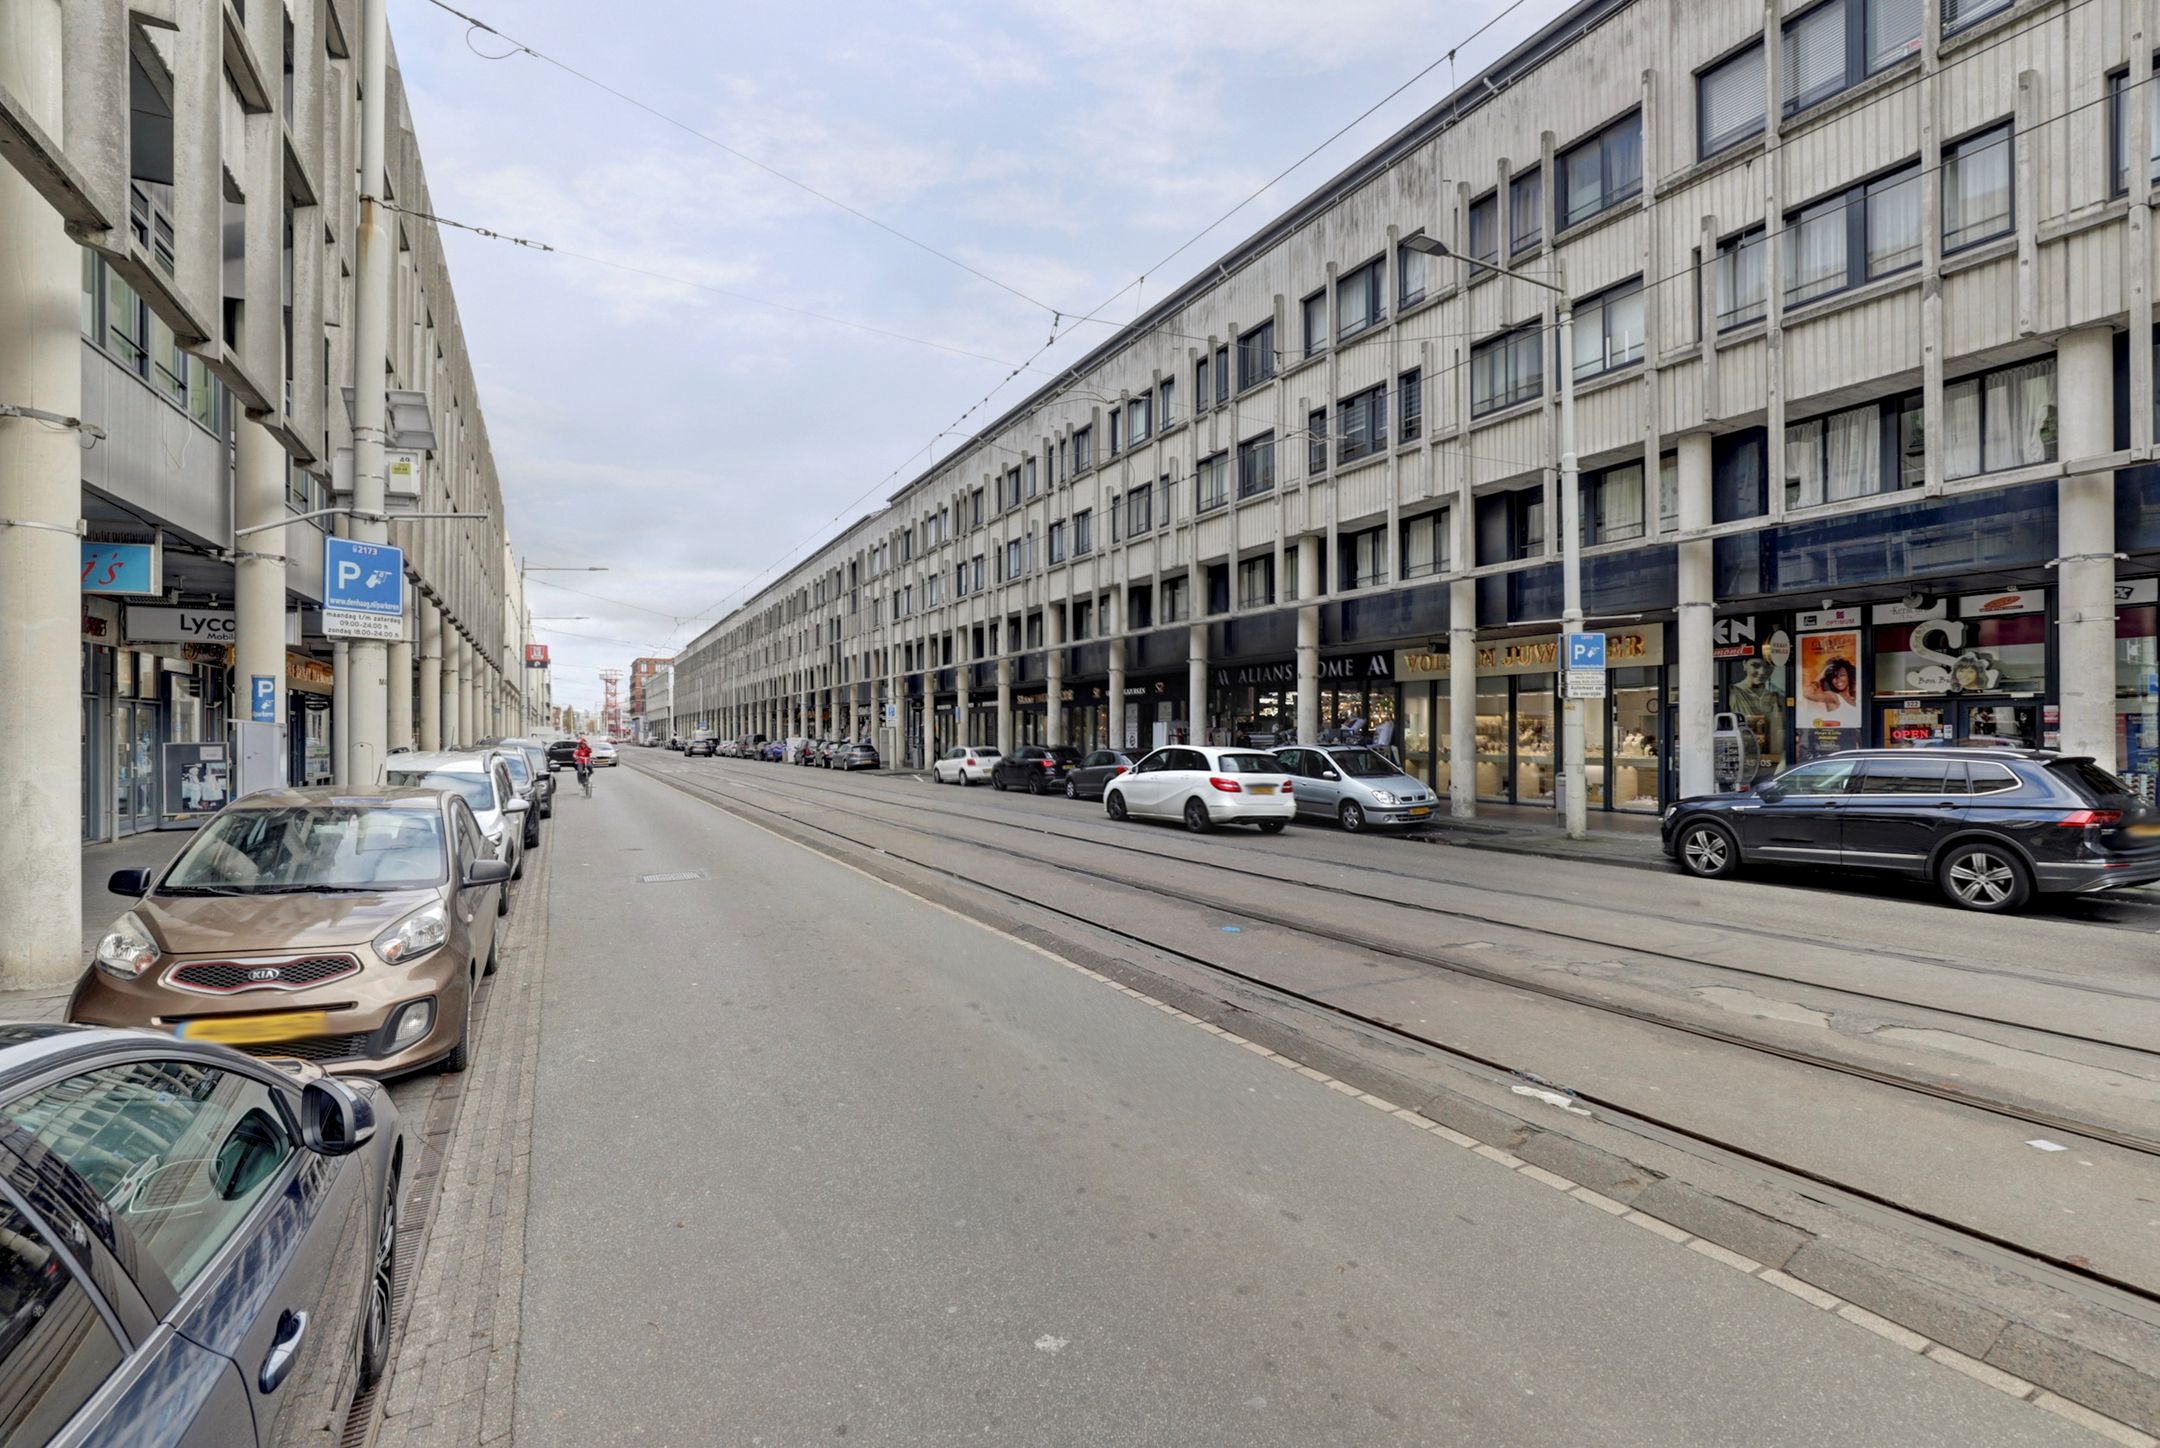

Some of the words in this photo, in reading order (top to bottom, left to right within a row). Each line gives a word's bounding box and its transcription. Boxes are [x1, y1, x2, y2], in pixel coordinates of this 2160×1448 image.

[358, 545, 377, 555] 2173
[207, 633, 235, 641] Mobil
[1404, 648, 1496, 673] VOLN
[1503, 634, 1646, 667] JUWER
[1238, 664, 1293, 684] ALIANS
[1317, 659, 1354, 679] OME
[1893, 730, 1929, 739] OPEN
[252, 970, 274, 979] KIA
